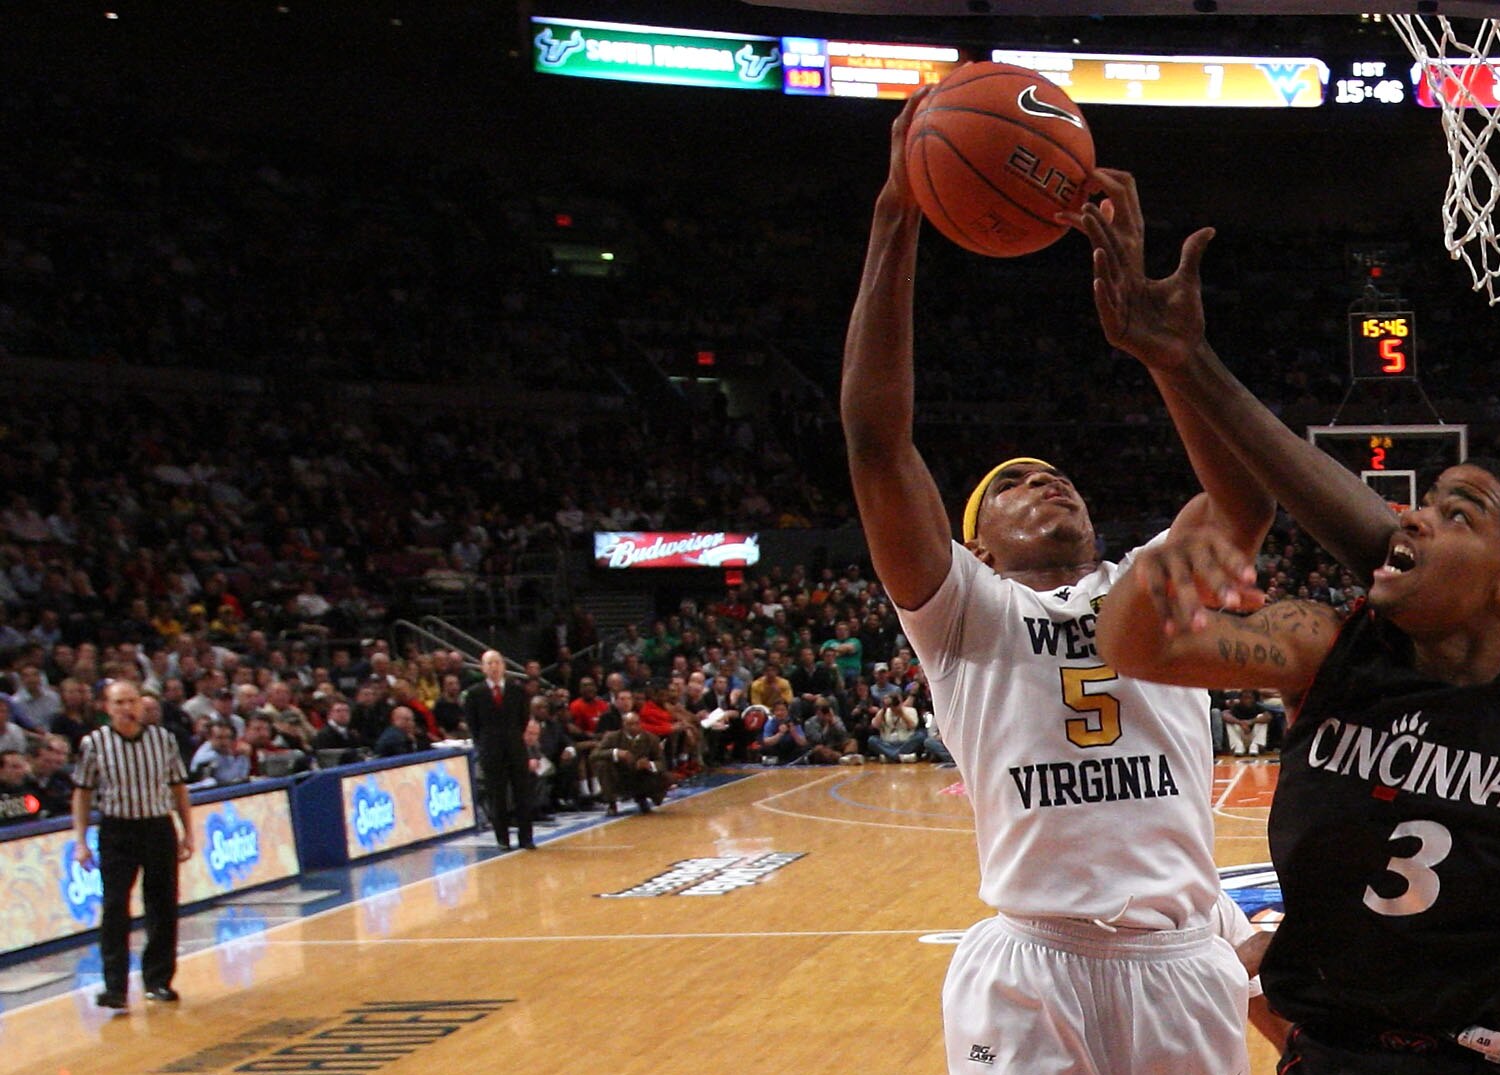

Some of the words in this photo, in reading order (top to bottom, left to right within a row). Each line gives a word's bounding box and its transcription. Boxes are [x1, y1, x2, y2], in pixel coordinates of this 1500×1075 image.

[1336, 80, 1404, 104] 15:46
[1362, 318, 1409, 338] 15:46
[1379, 338, 1406, 373] 5
[606, 532, 725, 568] Budweiser
[1023, 613, 1097, 660] WES
[1059, 664, 1123, 749] 5
[1009, 754, 1180, 810] VIRGINIA
[1362, 819, 1453, 917] 3
